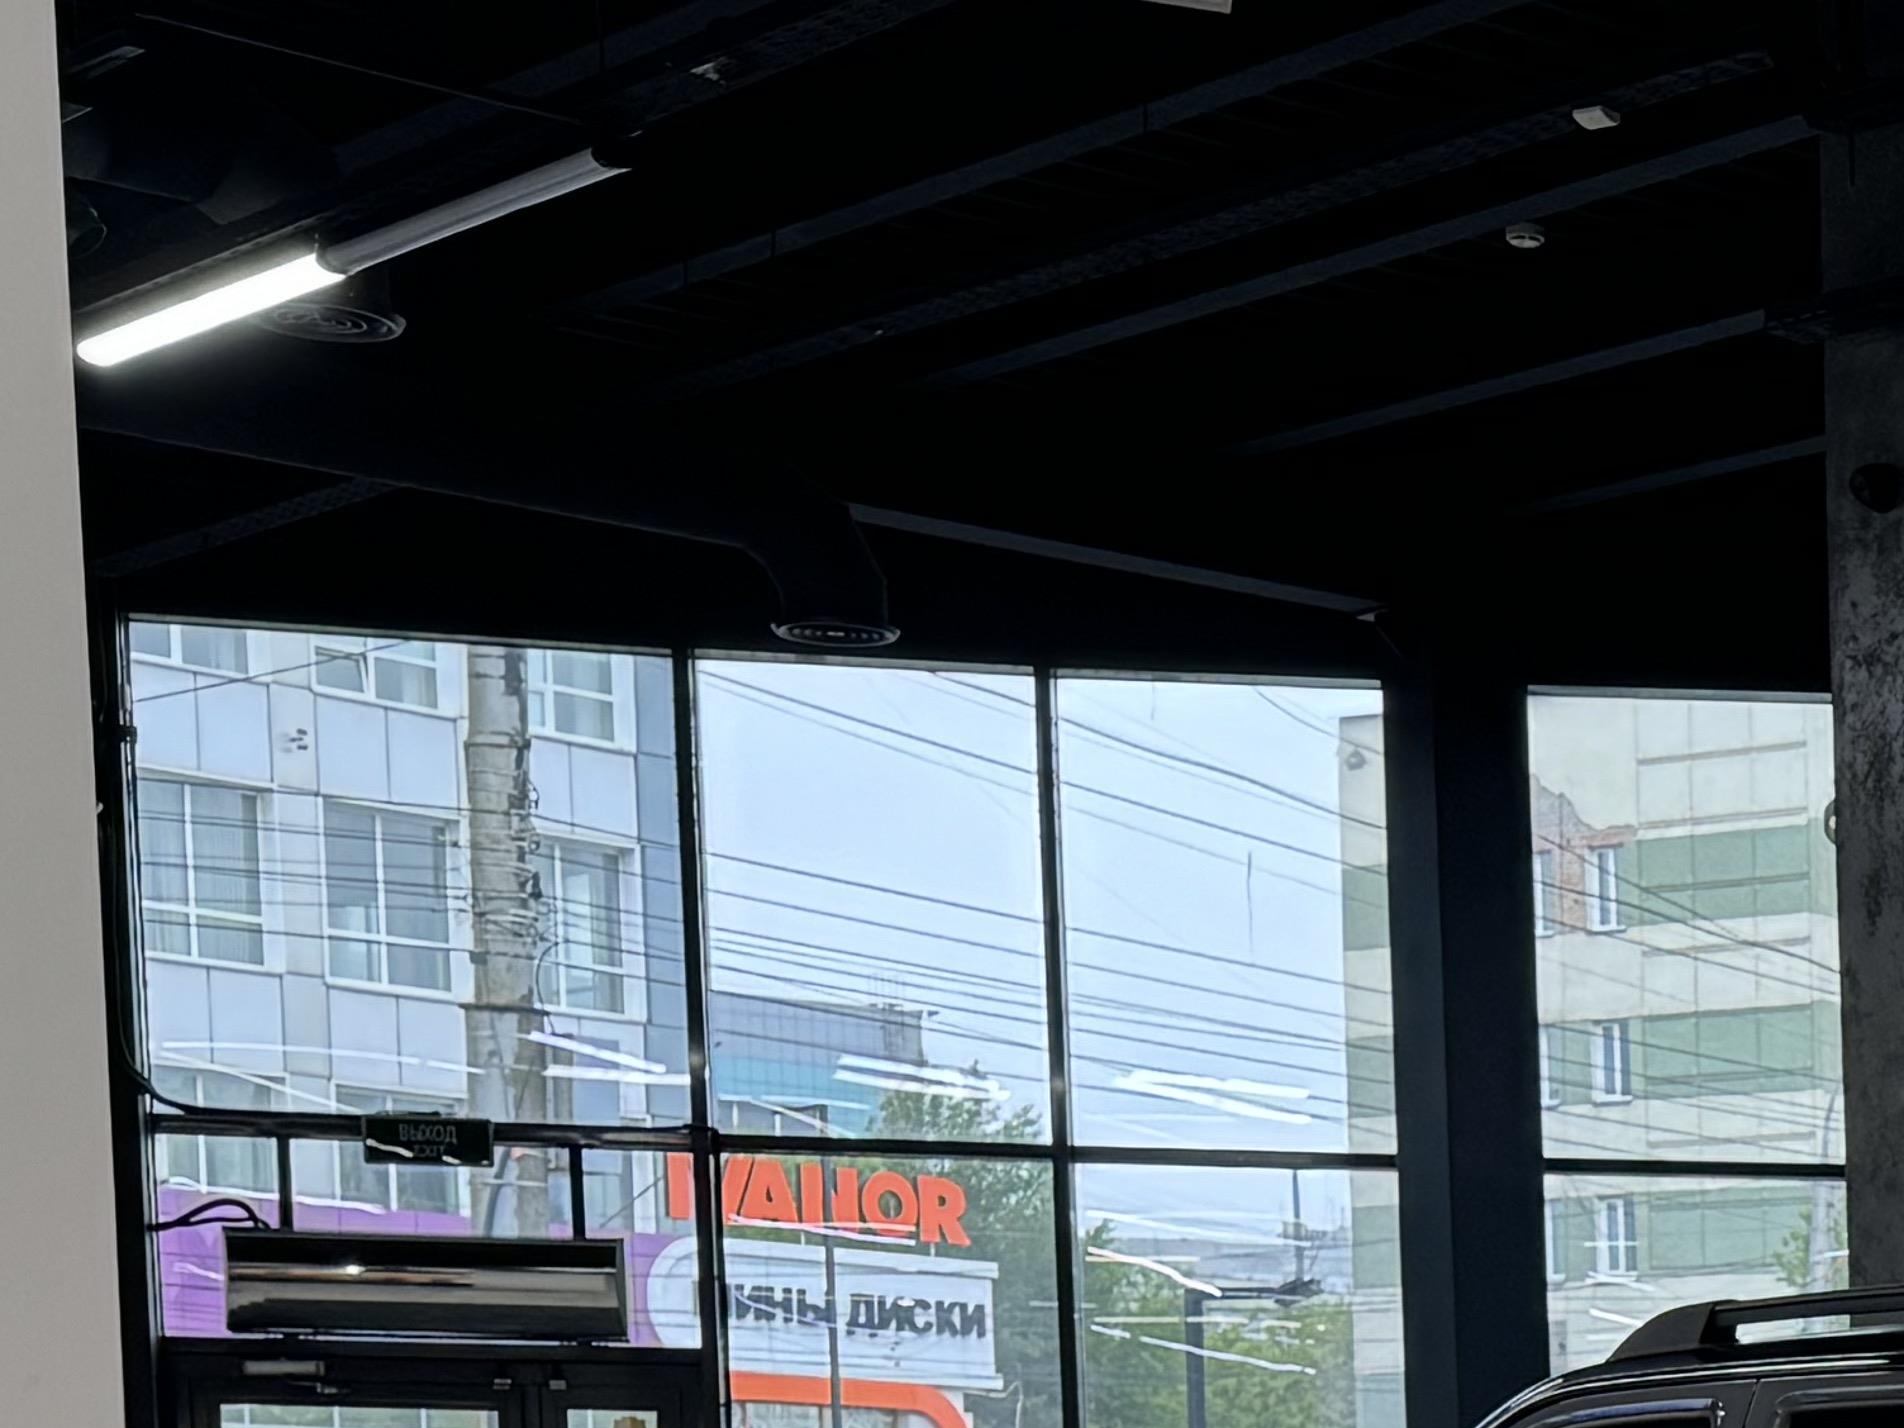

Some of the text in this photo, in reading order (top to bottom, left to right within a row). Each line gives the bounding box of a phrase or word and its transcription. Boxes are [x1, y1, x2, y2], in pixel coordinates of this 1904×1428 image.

[399, 1123, 458, 1145] ВЫХОД
[692, 1281, 986, 1338] ИНЫ ДИСКИ
